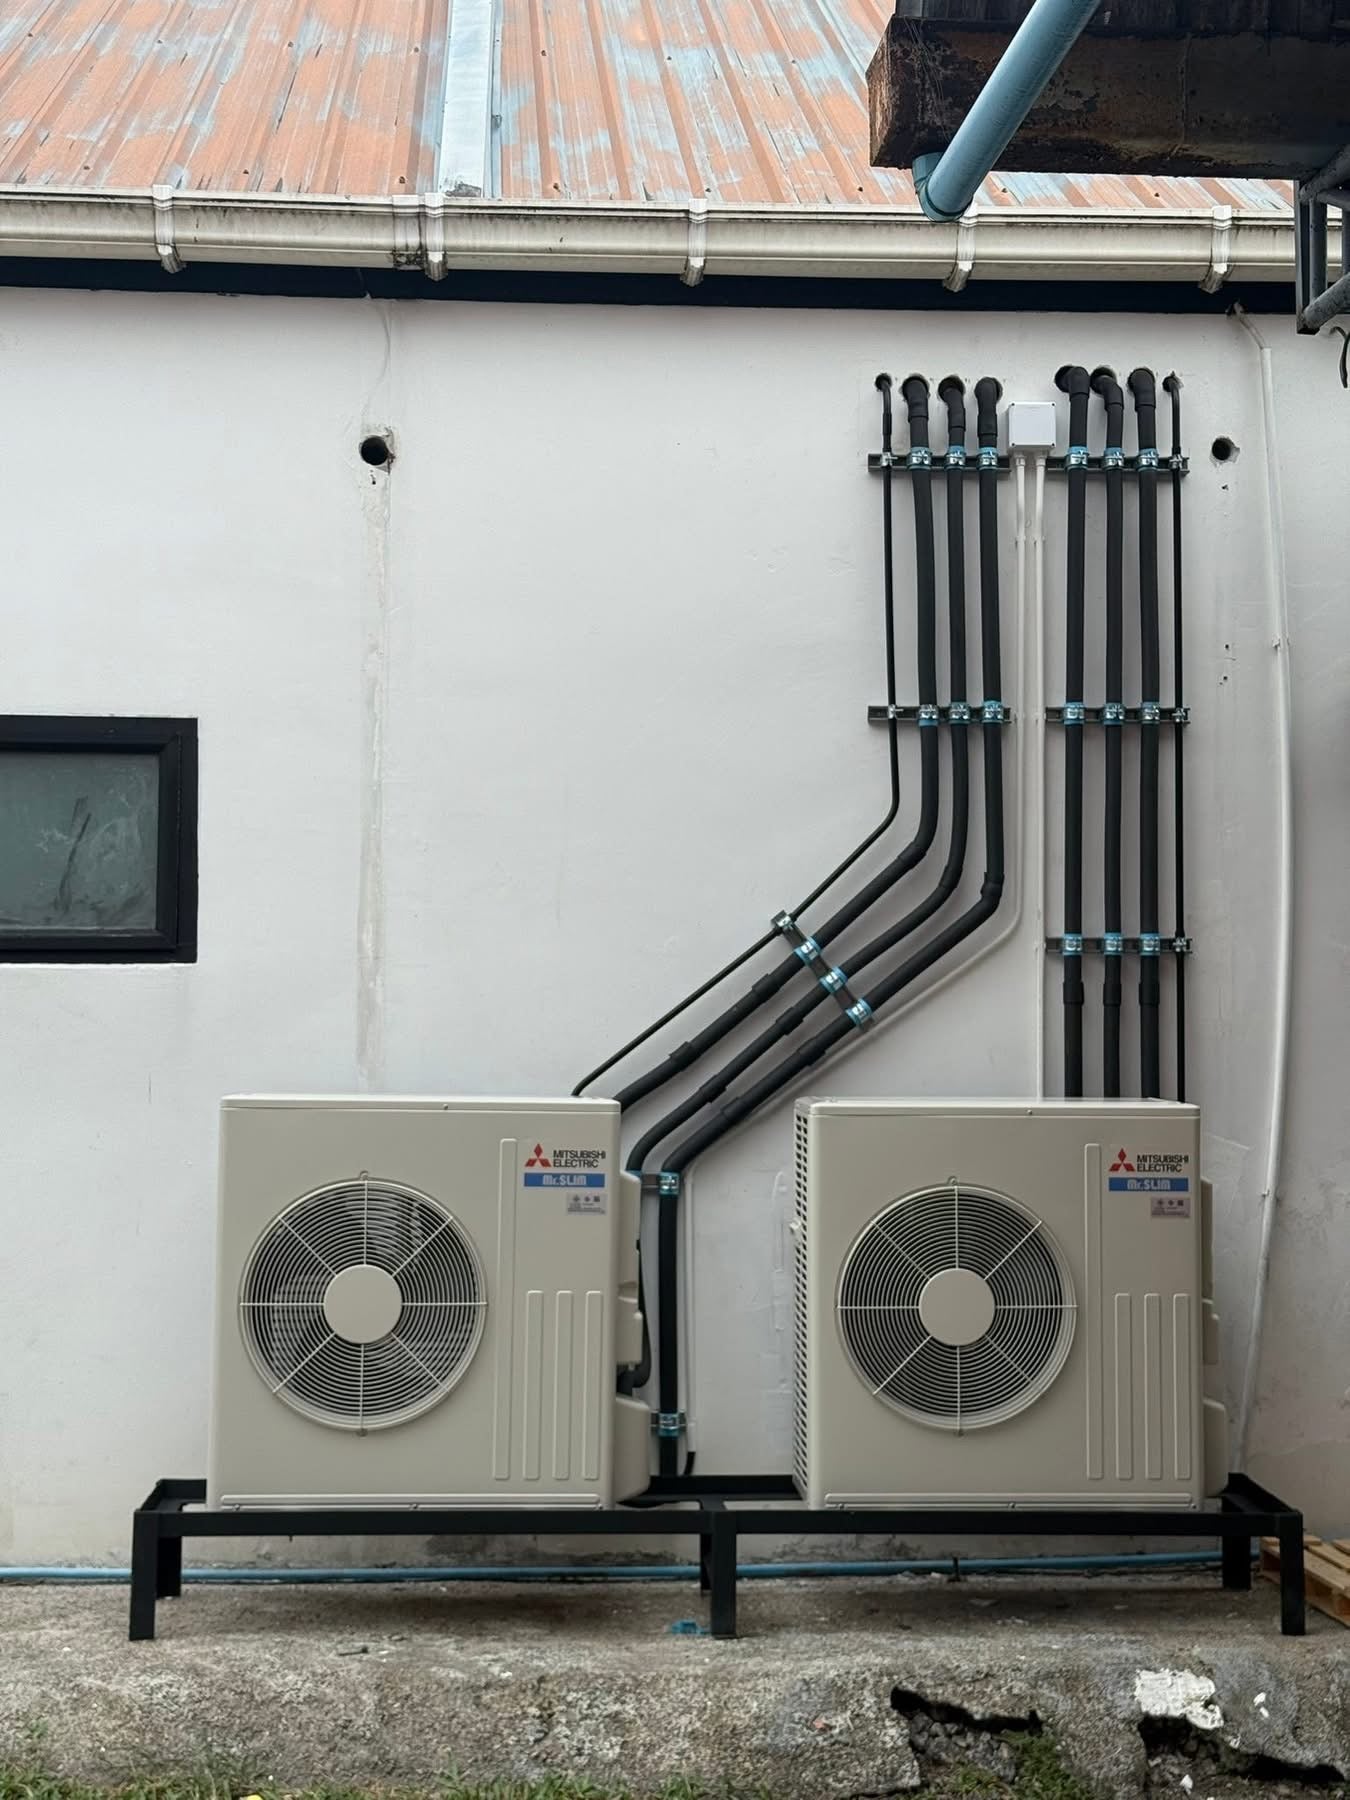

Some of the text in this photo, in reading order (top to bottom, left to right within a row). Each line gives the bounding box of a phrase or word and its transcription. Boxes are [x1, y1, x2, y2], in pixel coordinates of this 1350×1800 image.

[553, 1150, 606, 1159] MITSUBISHI
[1137, 1154, 1189, 1163] MITSUBISHI
[553, 1159, 599, 1168] ELECTRIC
[1137, 1163, 1182, 1172] ELECTRIC
